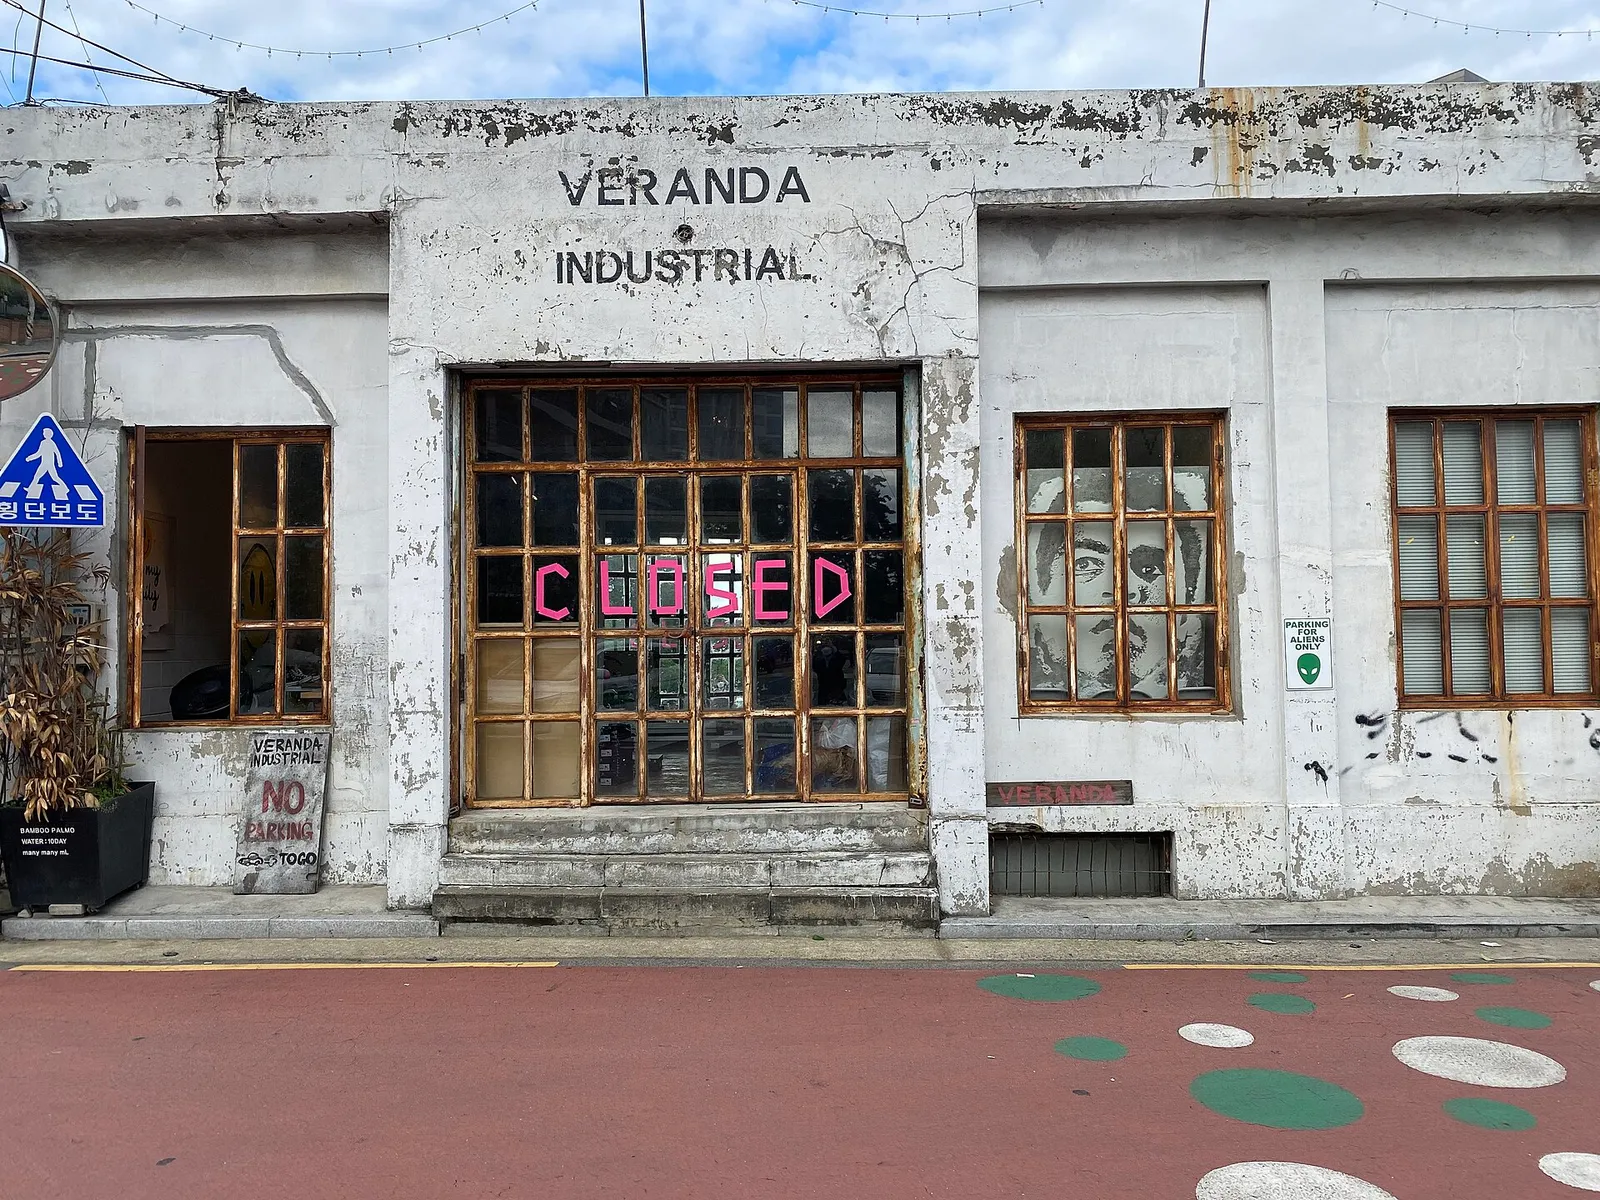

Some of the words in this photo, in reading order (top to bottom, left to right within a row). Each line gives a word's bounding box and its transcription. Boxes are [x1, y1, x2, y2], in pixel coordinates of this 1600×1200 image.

[558, 166, 811, 205] VERANDA
[556, 248, 812, 284] INDUSTRIAL
[0, 501, 97, 520] 횡단보도
[536, 557, 851, 620] CLOSED
[1290, 635, 1325, 643] ALIENS
[254, 737, 323, 753] VERANDA
[250, 751, 321, 768] INDUSTRIAL
[261, 780, 305, 815] NO
[998, 783, 1116, 805] VERANDA
[244, 821, 314, 843] PARKING
